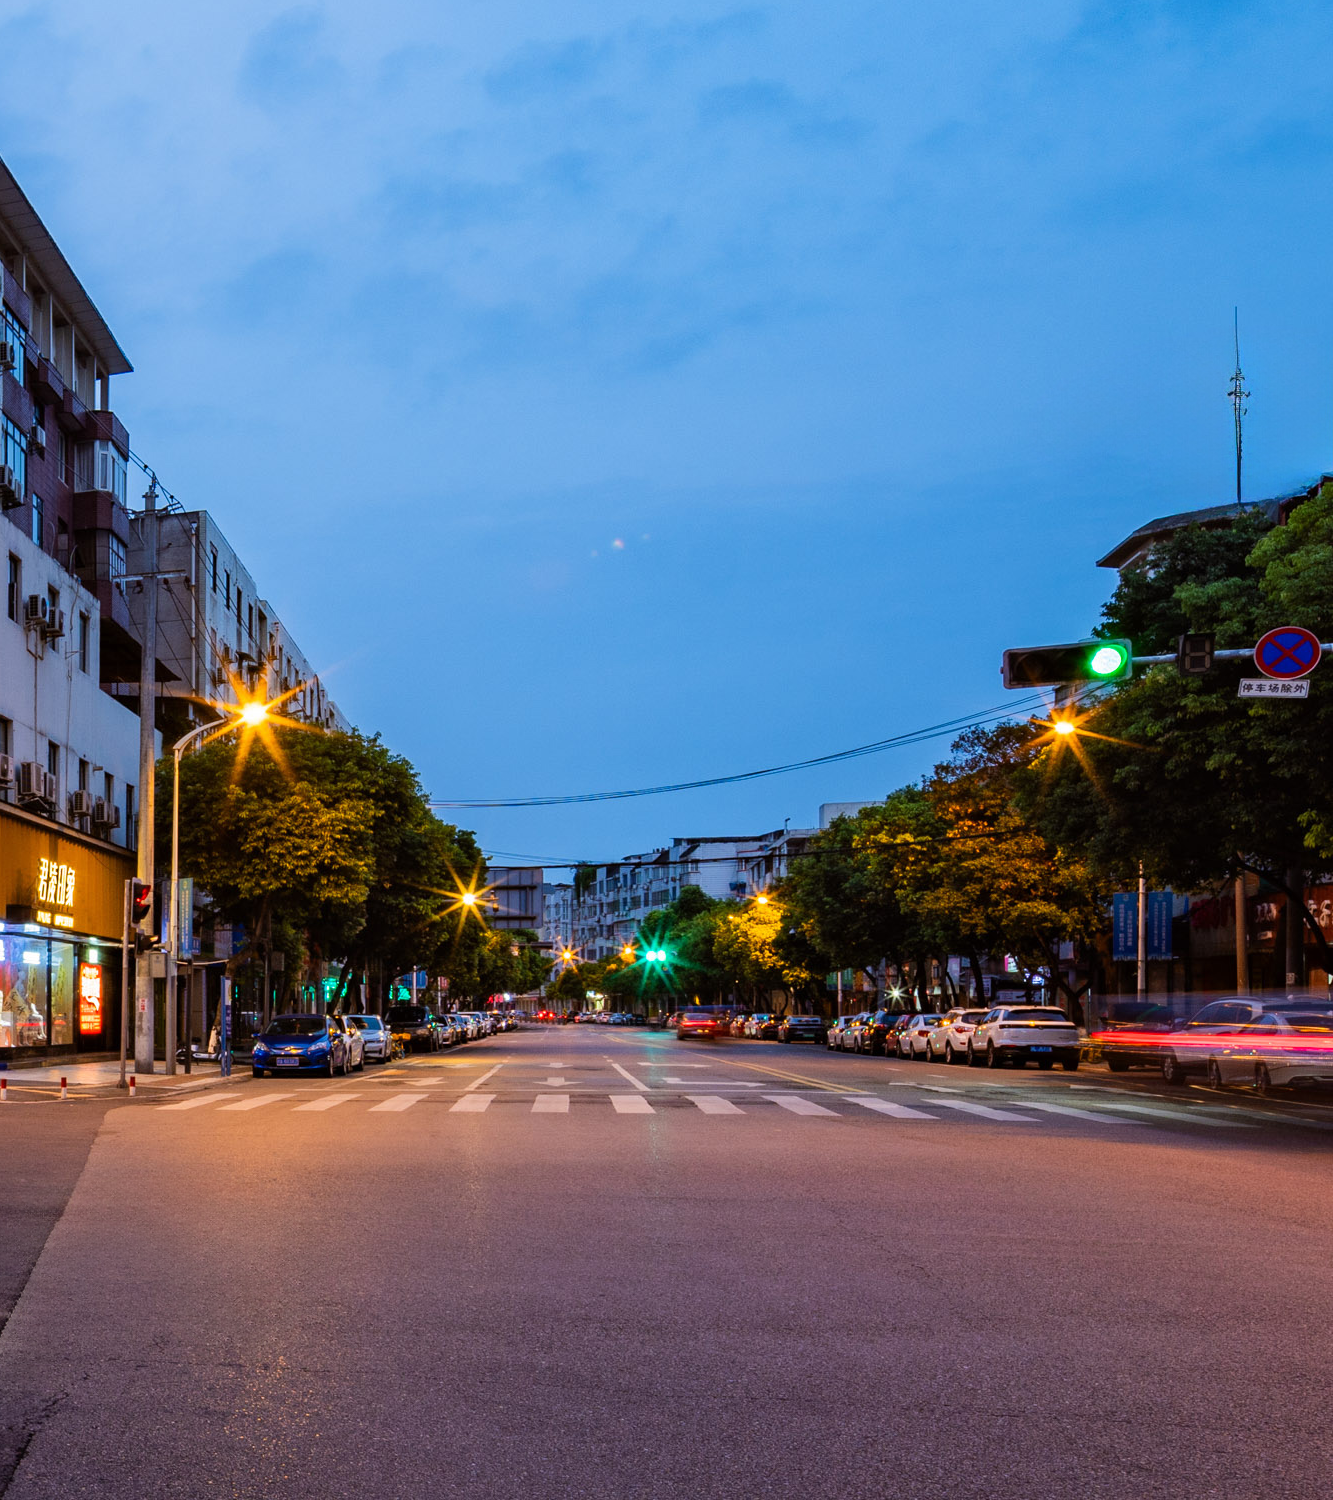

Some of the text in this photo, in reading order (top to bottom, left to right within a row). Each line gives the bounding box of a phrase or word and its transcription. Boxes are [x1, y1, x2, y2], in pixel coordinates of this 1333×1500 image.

[1243, 683, 1305, 693] 停车场除外
